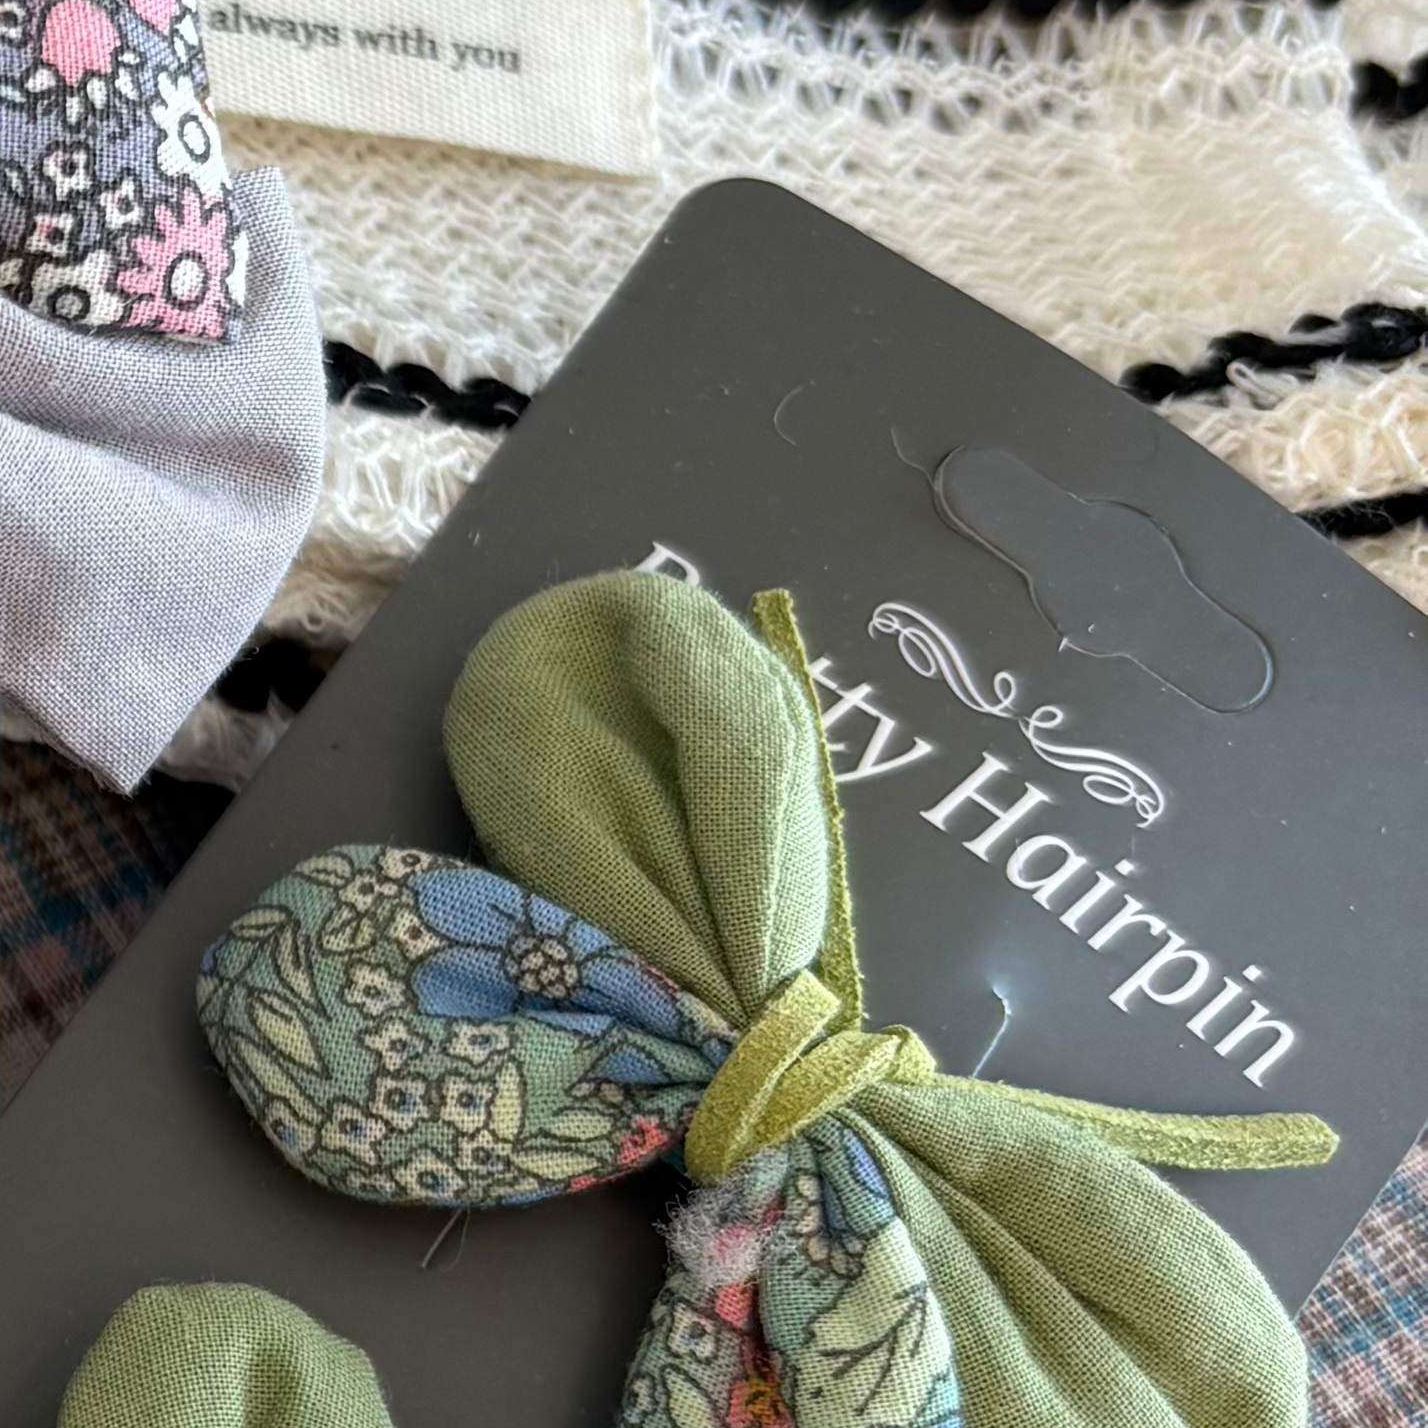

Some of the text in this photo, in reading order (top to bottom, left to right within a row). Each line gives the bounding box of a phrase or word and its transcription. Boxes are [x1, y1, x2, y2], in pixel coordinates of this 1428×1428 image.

[208, 2, 520, 73] always with you
[920, 752, 1299, 1089] Hairpin
